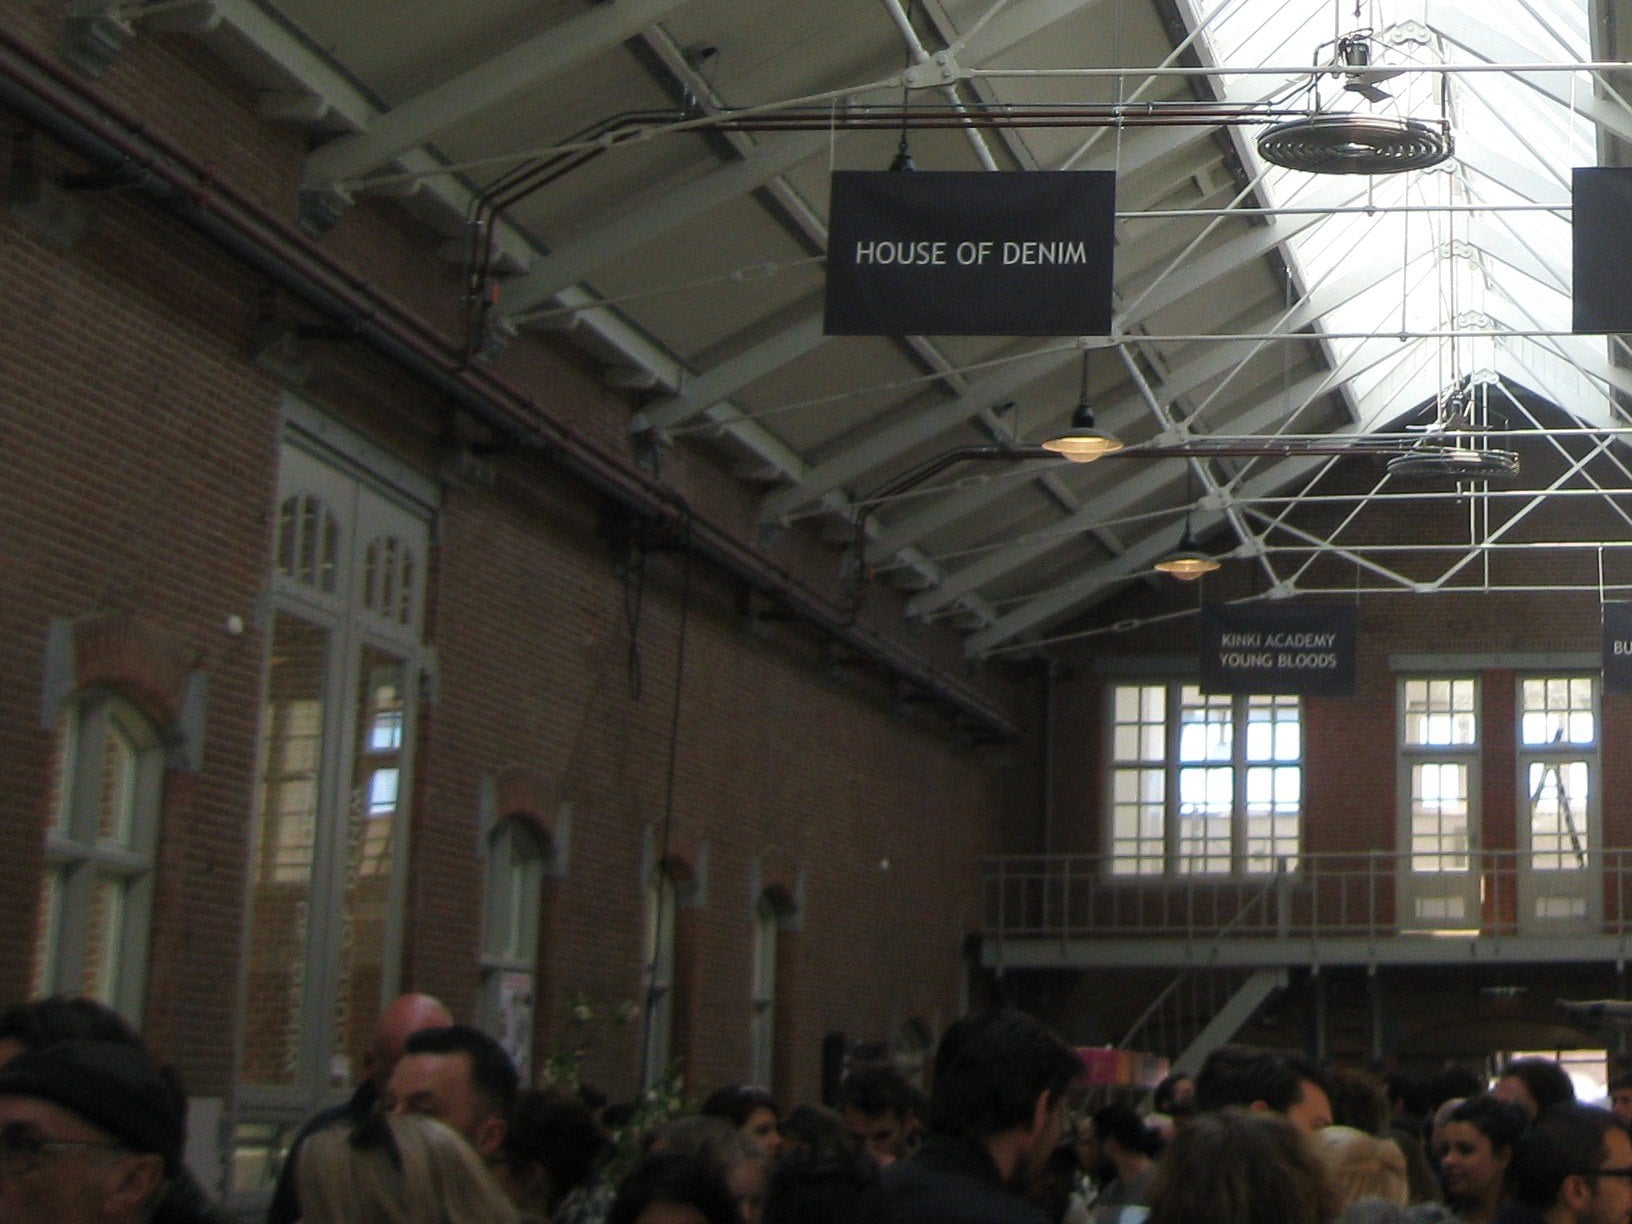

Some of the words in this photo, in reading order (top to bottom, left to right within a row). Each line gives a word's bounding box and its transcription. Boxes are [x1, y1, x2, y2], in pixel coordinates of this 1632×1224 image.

[856, 241, 947, 265] HOUSE
[956, 241, 994, 265] OF
[1002, 241, 1087, 265] DENIM
[1221, 633, 1261, 648] KINKI
[1263, 633, 1337, 648] ACADEMY
[1218, 652, 1273, 668] YOUNG
[1277, 652, 1338, 668] BLOODS
